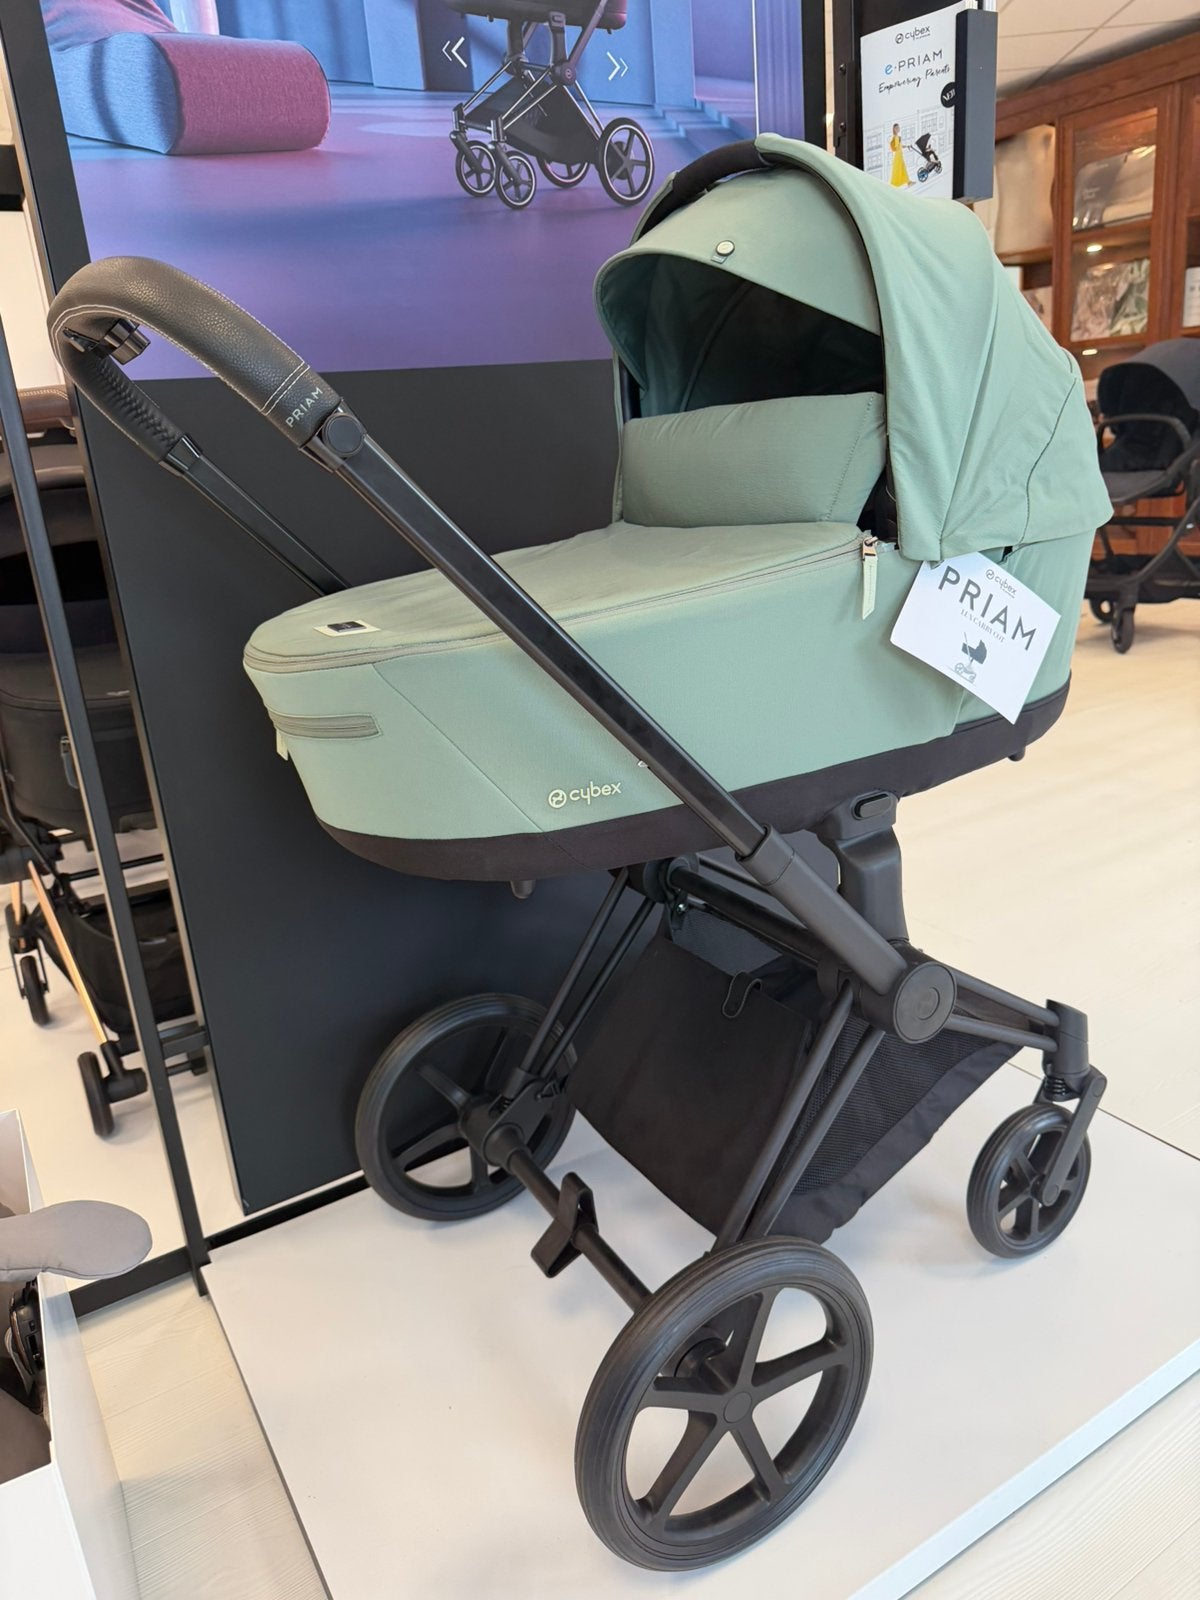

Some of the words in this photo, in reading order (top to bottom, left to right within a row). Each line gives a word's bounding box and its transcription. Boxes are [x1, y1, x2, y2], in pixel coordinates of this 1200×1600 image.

[904, 26, 931, 40] cybex
[925, 64, 951, 80] Parents
[285, 386, 324, 428] PRIAM
[994, 577, 1018, 595] cybex
[938, 565, 1037, 651] PRIAM
[569, 781, 621, 805] cybex
